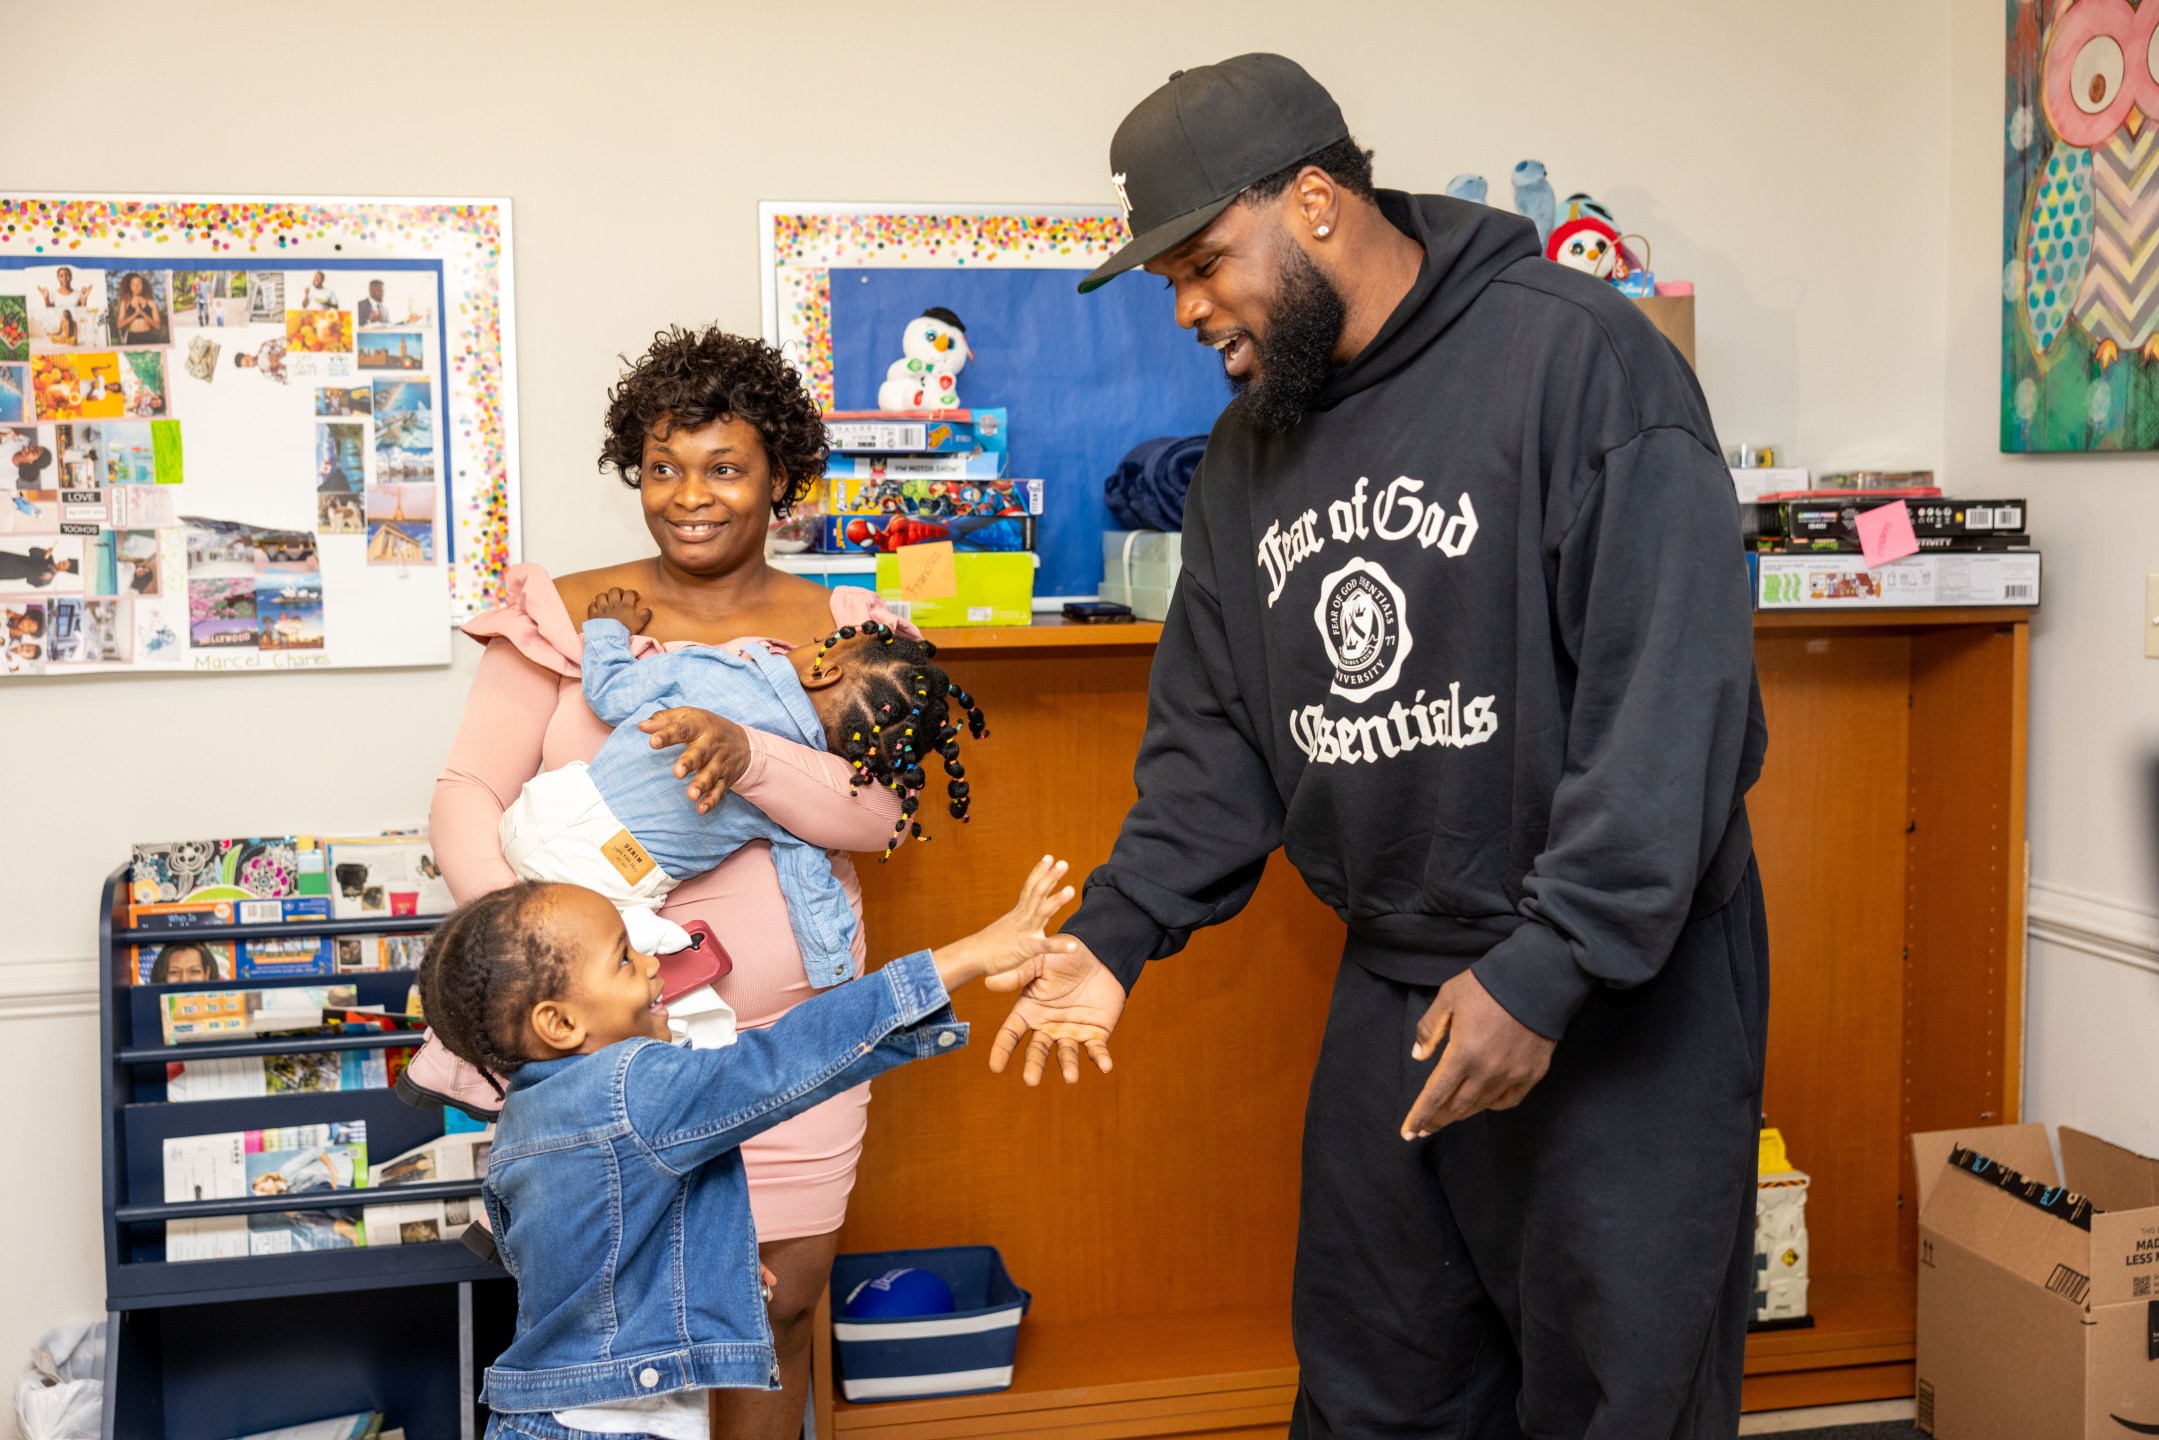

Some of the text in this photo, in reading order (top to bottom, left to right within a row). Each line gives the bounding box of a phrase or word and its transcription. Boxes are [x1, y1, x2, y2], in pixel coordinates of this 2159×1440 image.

[67, 493, 96, 503] LOVE
[62, 525, 98, 535] SCHOOL
[1258, 475, 1479, 609] Fear of God
[1340, 578, 1358, 596] GOD
[1333, 594, 1343, 609] OF
[1330, 610, 1340, 636] FEAR
[200, 632, 251, 646] HOLLYWOOD
[1385, 635, 1396, 646] 77
[193, 652, 261, 671] Marcel
[624, 843, 643, 863] DENIM
[2126, 1252, 2153, 1266] LESS
